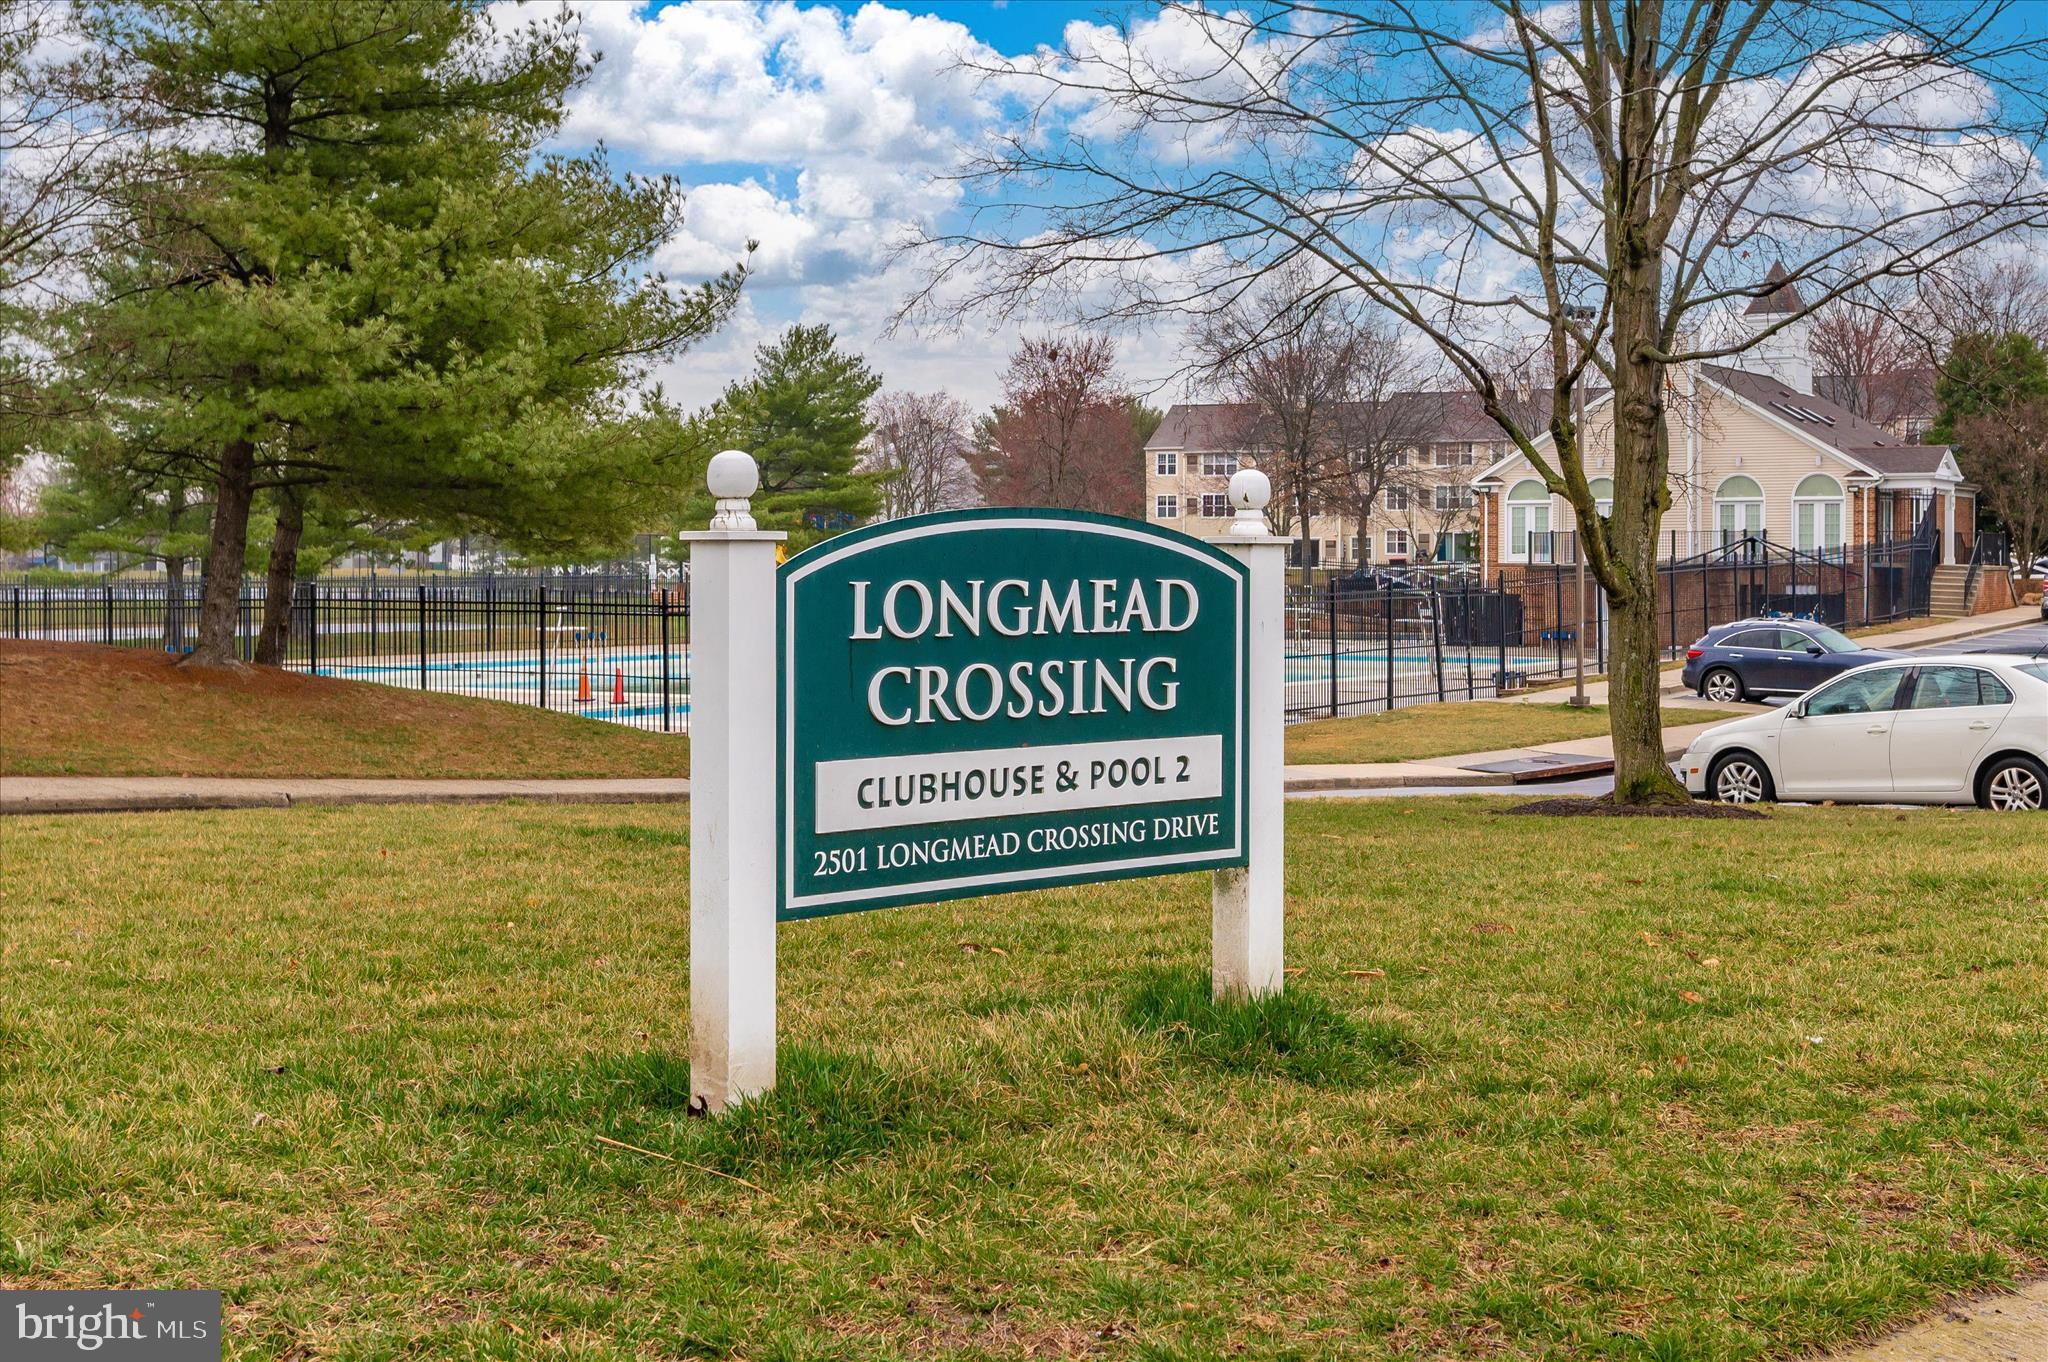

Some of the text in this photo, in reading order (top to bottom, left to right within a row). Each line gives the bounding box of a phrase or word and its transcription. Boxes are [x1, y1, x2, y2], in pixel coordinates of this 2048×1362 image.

[849, 578, 1199, 640] LONGMEAD
[867, 656, 1180, 726] CROSSING
[857, 755, 1191, 809] CLUBHOUSE & POOL 2
[814, 813, 1219, 876] 2501 LONGMEAD CROSSING DRIVE
